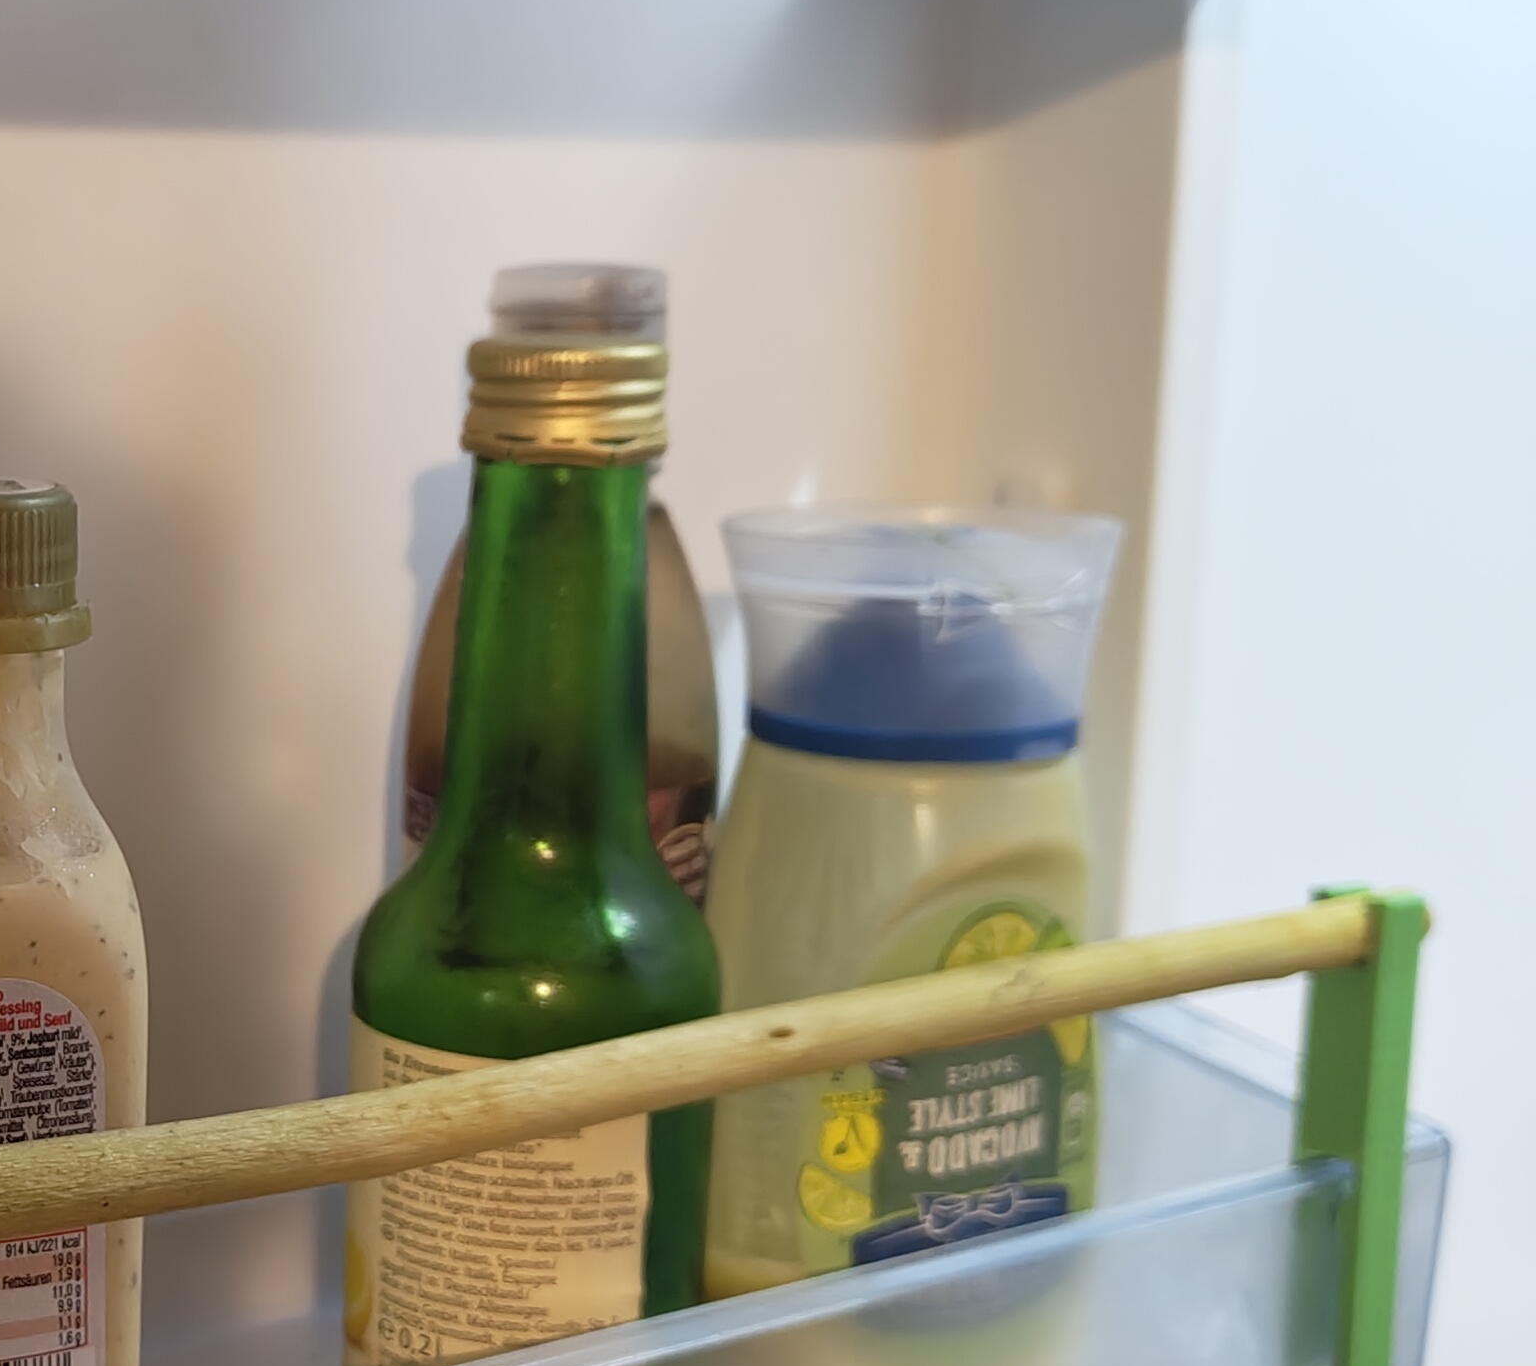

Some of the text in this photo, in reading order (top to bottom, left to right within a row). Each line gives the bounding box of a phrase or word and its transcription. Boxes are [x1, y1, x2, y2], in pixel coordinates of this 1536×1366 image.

[18, 1014, 41, 1030] und
[44, 1010, 72, 1027] Senf
[11, 1034, 25, 1046] 9%
[27, 1029, 60, 1046] Joghurt
[908, 1089, 983, 1134] STYLE
[6, 1242, 24, 1258] 914
[62, 1233, 81, 1249] kcal
[52, 1251, 73, 1267] 19,0
[2, 1272, 52, 1290] Fettsäuren
[58, 1266, 73, 1282] 1,9
[52, 1283, 73, 1299] 11,0
[57, 1298, 73, 1314] 9,9
[58, 1315, 72, 1330] 1,1
